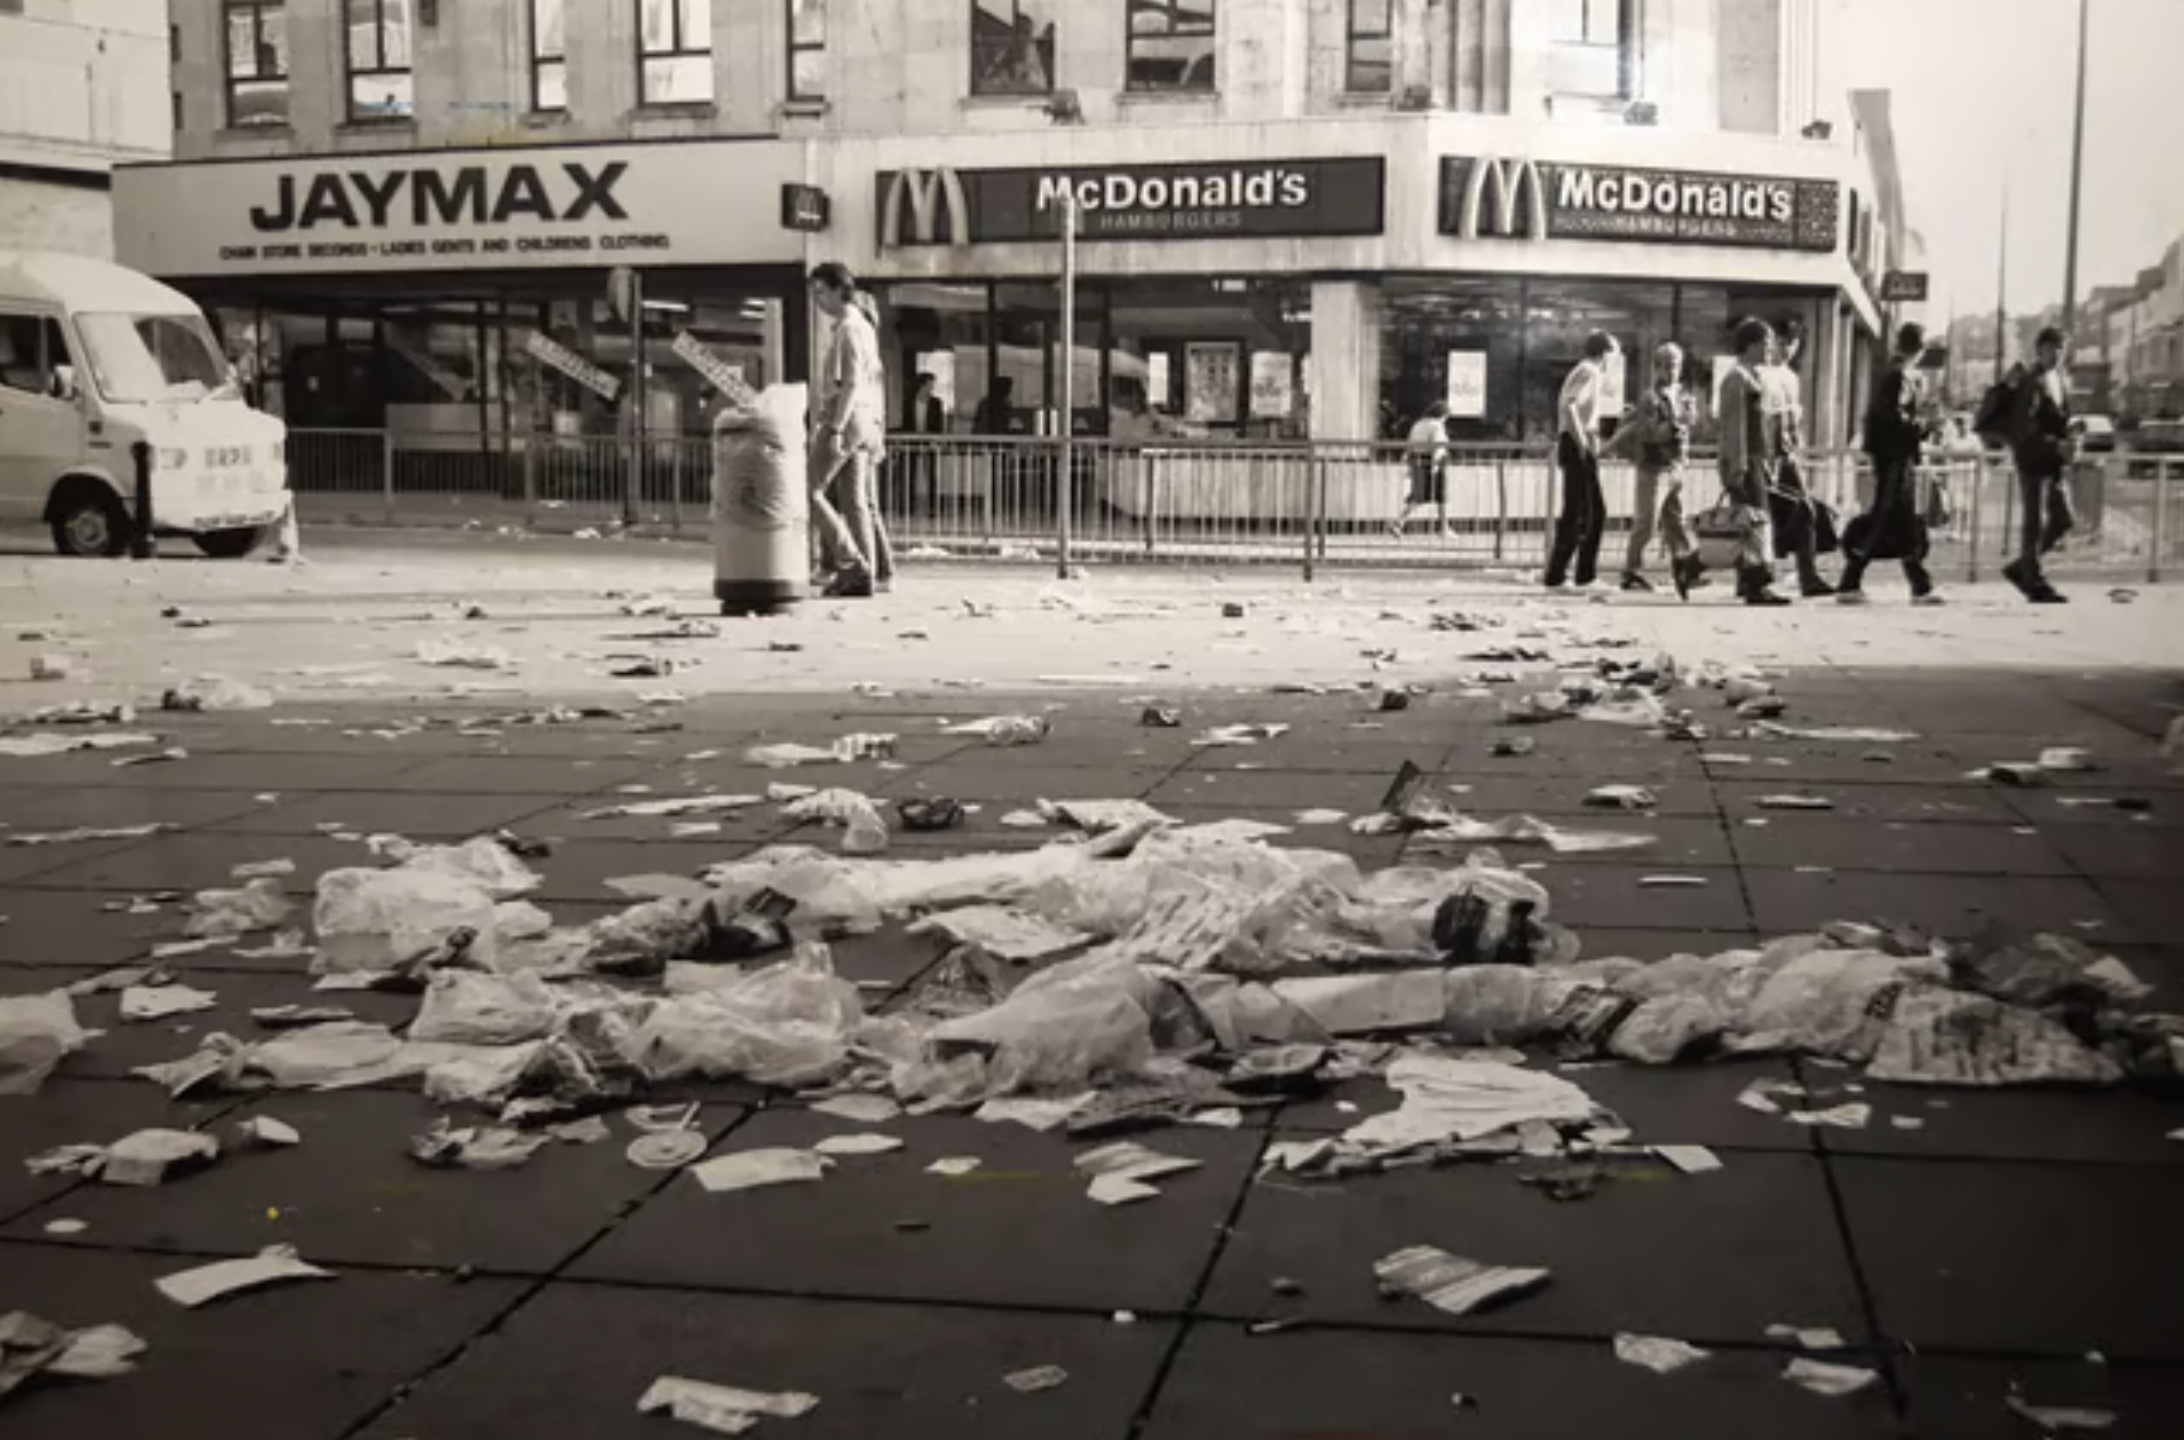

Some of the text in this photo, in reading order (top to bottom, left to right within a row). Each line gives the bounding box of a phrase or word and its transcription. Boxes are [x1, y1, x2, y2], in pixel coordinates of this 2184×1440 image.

[250, 161, 630, 232] JAYMAX
[1036, 169, 1307, 211] McDonald's
[1557, 168, 1793, 221] McDonald's
[1100, 211, 1243, 231] HAMBURGERS
[262, 243, 301, 259] STORE
[380, 240, 425, 256] LADIES
[431, 238, 475, 253] GENTS
[482, 238, 509, 251] AND
